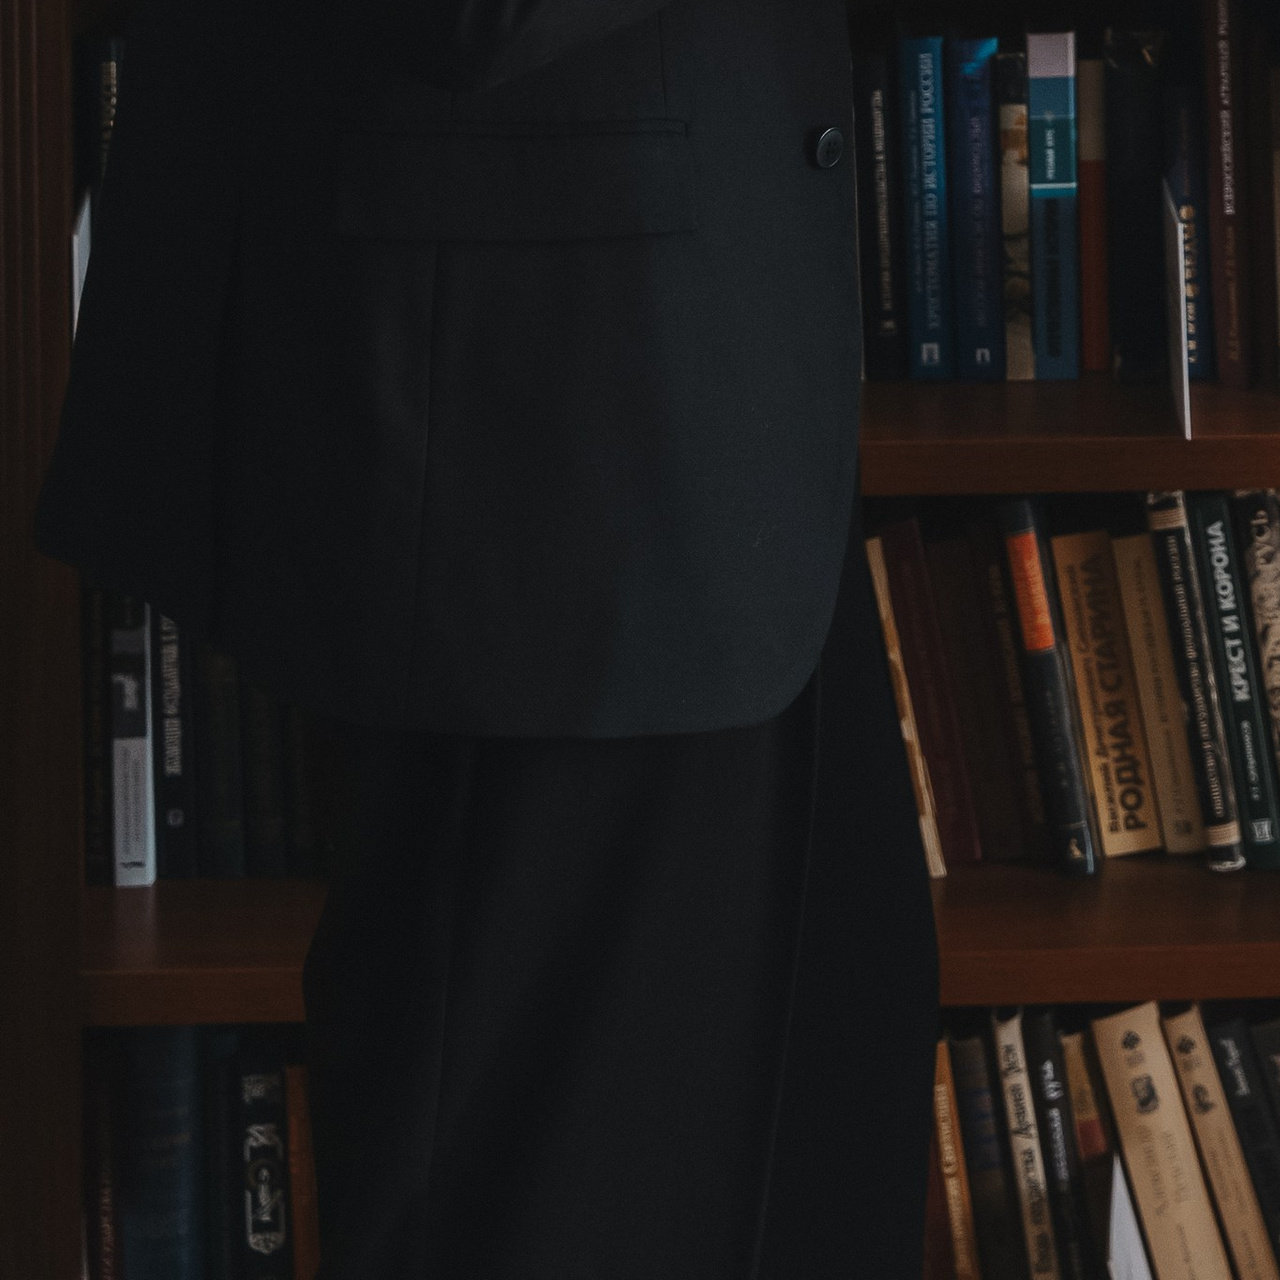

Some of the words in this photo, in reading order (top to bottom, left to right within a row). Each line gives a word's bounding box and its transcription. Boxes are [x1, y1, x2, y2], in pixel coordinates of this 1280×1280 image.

[919, 53, 937, 113] РОССИИ
[920, 117, 937, 188] ИСТОРИИ
[921, 193, 938, 216] ПО
[921, 220, 939, 328] ХРЕСТОМАТИЯ
[1205, 519, 1237, 611] КОРОНА
[1076, 556, 1124, 695] СТАРИНА
[1220, 613, 1240, 633] И
[1188, 660, 1213, 739] ГОСУДАРСТВО
[1223, 634, 1251, 702] КРЕСТ
[1103, 698, 1150, 831] РОДНАЯ
[1204, 749, 1227, 817] ОБЩЕСТВО
